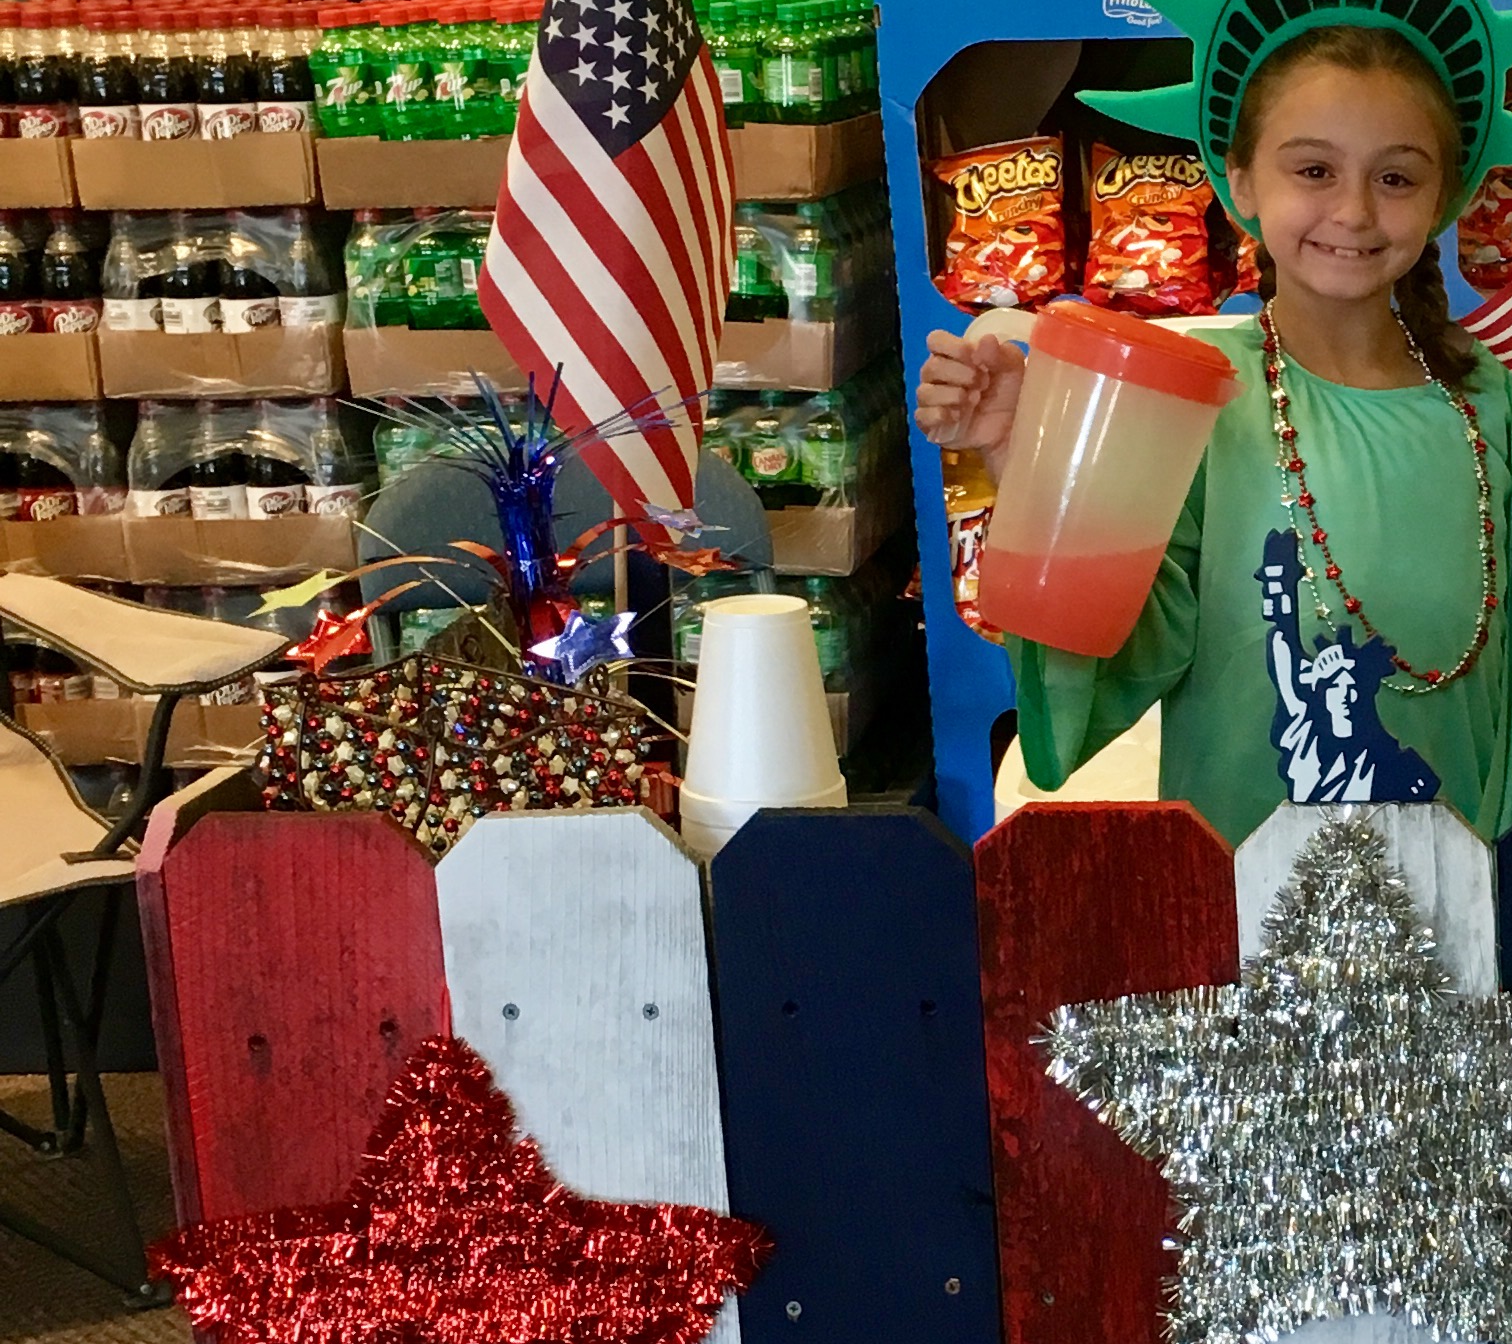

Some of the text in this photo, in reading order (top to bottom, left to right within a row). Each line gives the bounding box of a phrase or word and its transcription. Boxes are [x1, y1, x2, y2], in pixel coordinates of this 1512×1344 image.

[951, 150, 1060, 215] Cheetos
[1096, 156, 1208, 200] Cheetos
[1126, 184, 1184, 206] Crunchy
